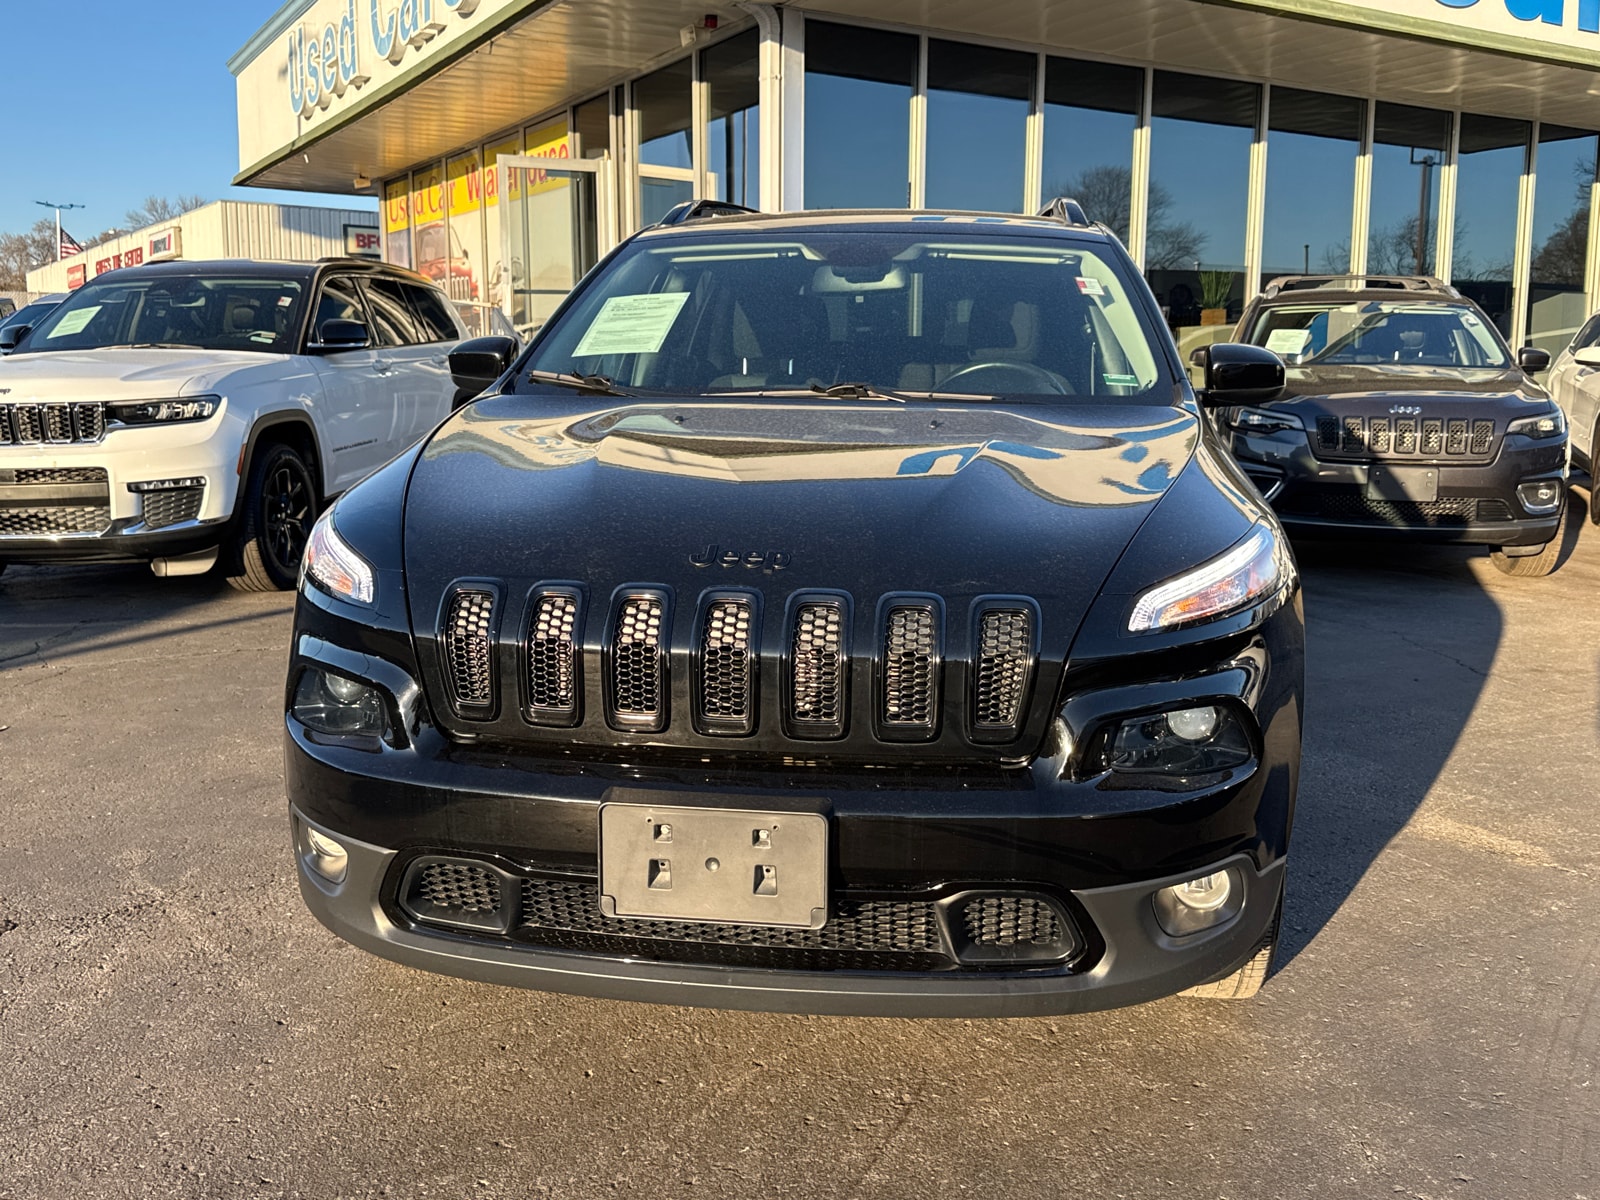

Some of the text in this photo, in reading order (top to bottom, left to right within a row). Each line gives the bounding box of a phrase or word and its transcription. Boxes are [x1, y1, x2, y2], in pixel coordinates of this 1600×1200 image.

[287, 0, 463, 115] Used Ca
[1388, 404, 1422, 415] Jeep
[689, 544, 792, 574] Jeep
